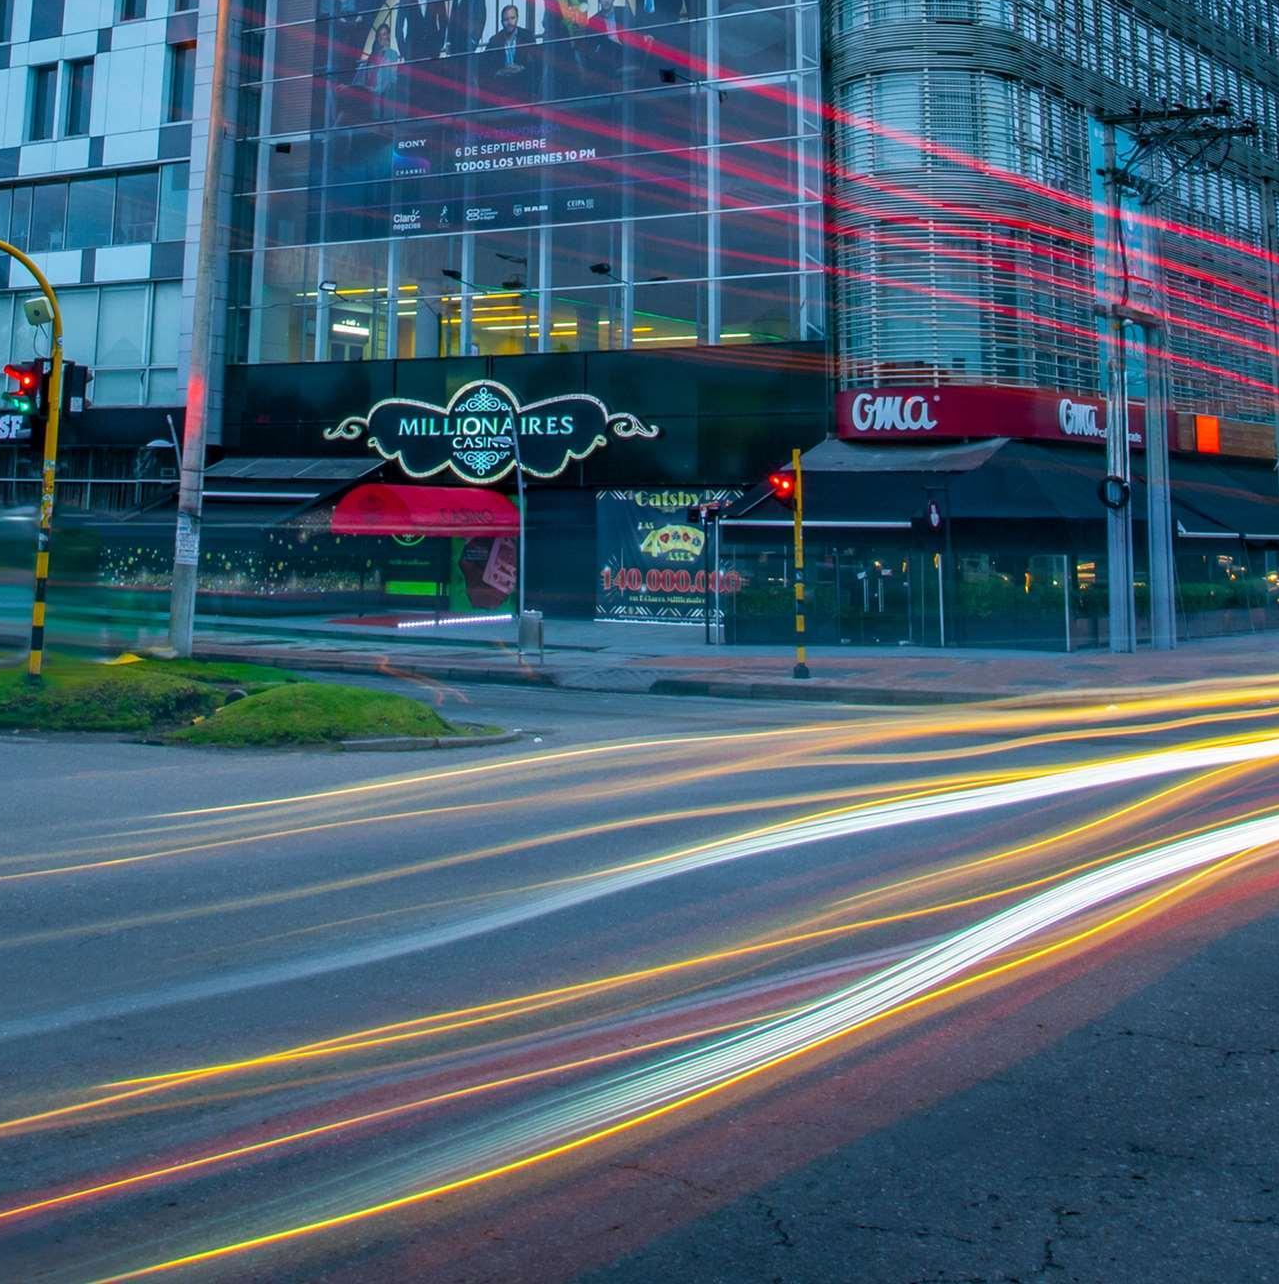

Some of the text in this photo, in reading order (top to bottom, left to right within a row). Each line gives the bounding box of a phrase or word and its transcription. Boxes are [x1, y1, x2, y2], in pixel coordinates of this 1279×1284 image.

[398, 139, 427, 149] SONY
[455, 138, 547, 157] 6 DE SEPTIEMBRE
[454, 148, 596, 173] TODOS LOS VIERNES 10 PM
[393, 212, 417, 224] Claro
[398, 416, 574, 436] MILLIONAIRES
[635, 490, 701, 508] Gatsby
